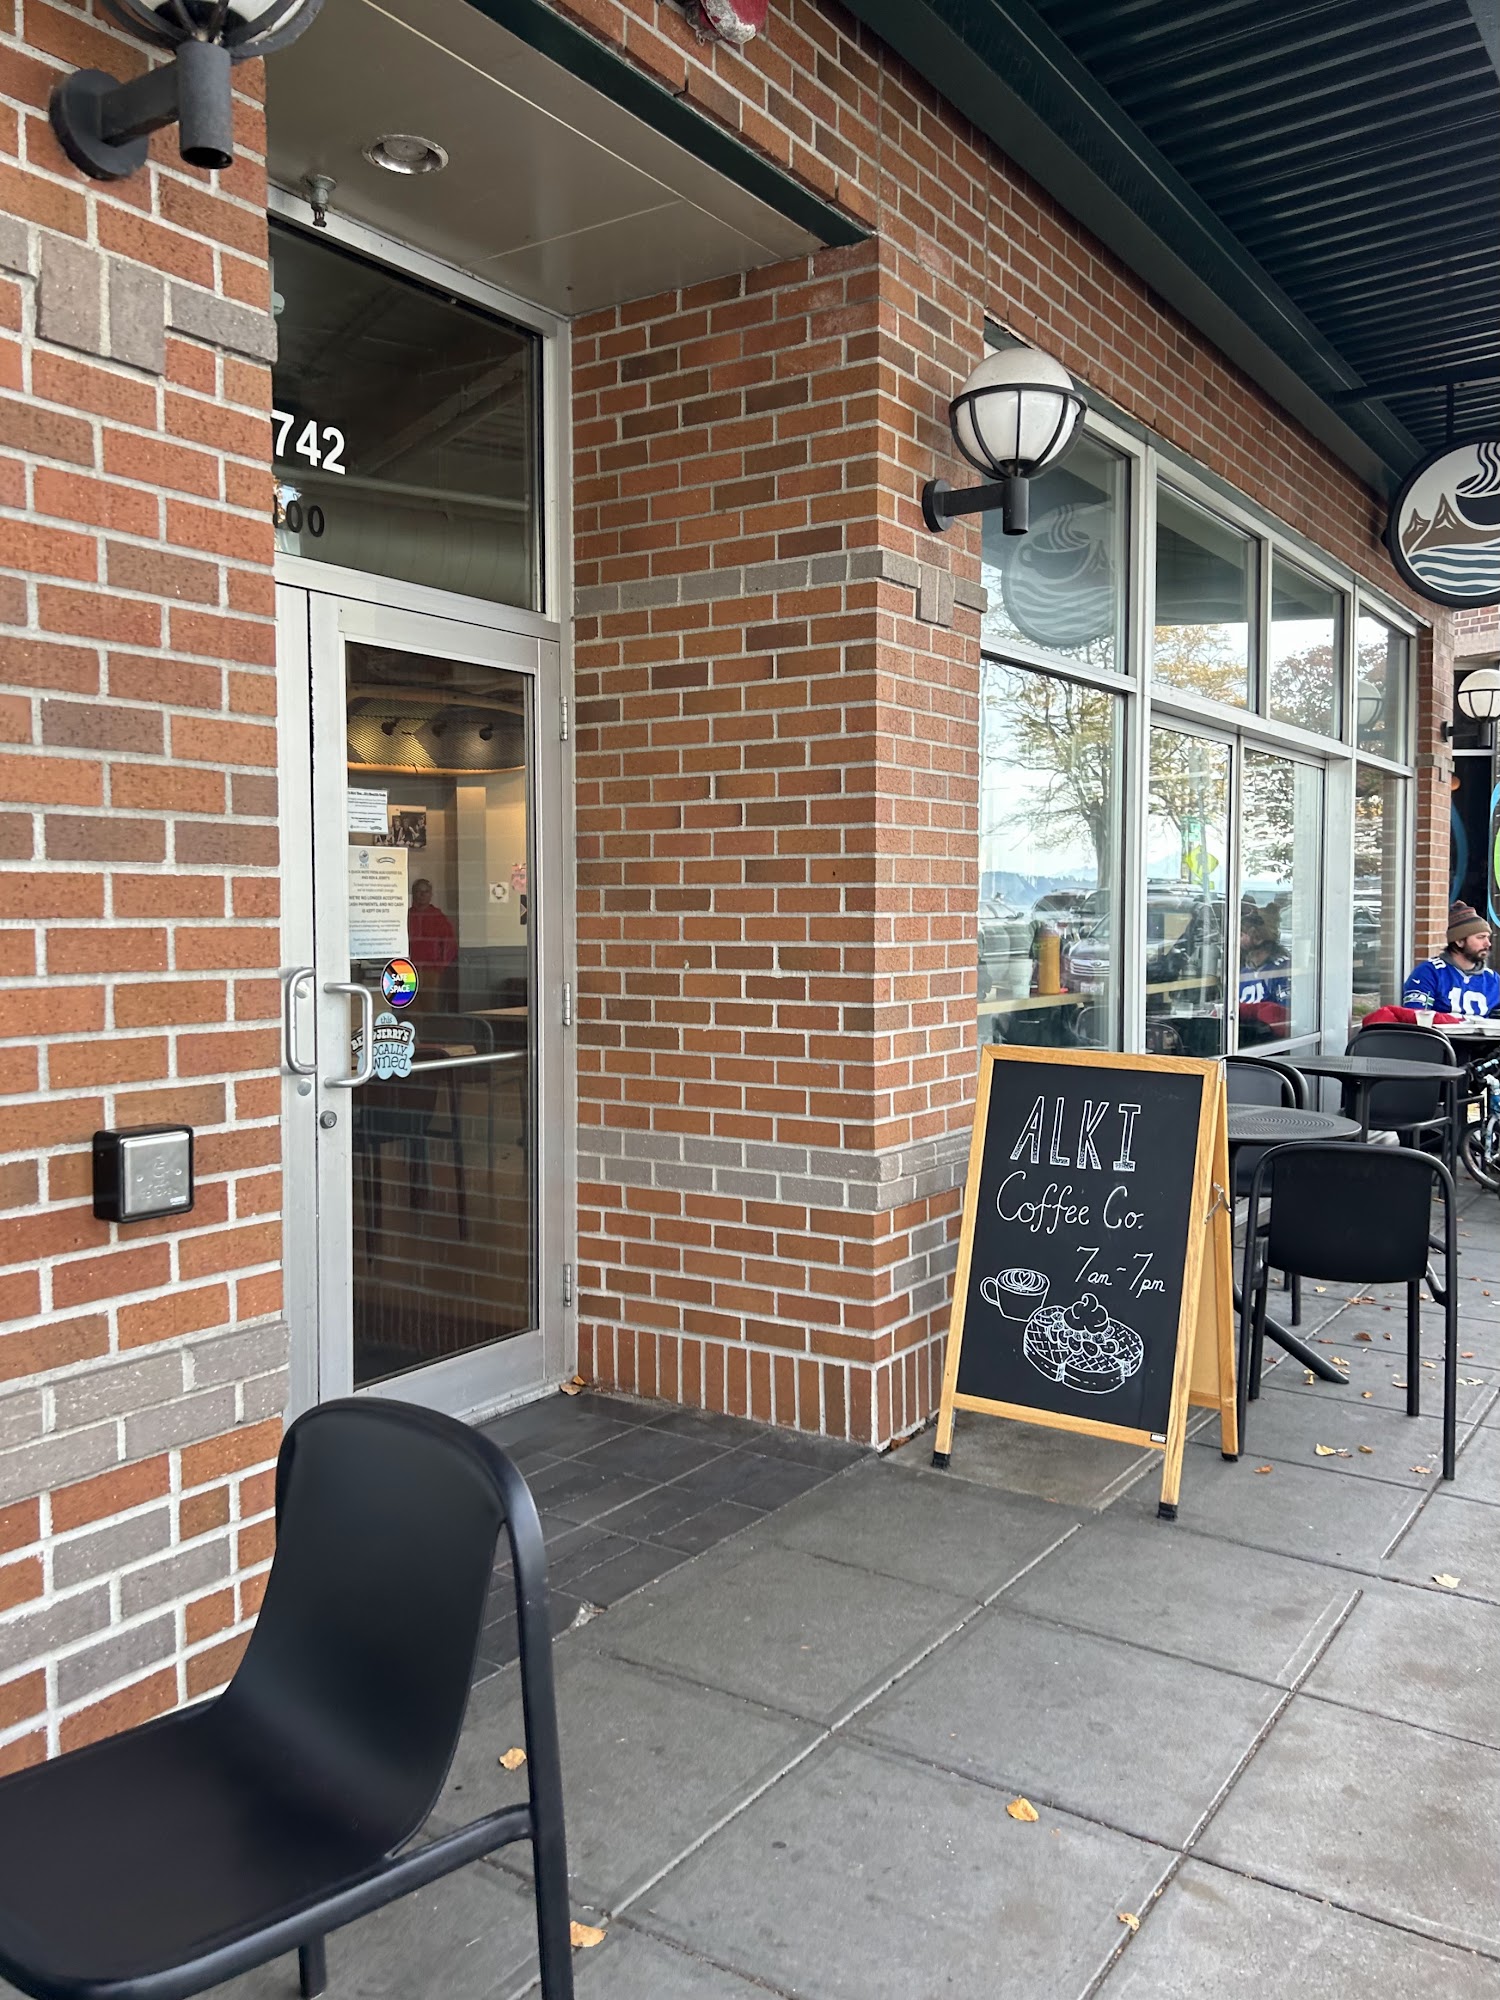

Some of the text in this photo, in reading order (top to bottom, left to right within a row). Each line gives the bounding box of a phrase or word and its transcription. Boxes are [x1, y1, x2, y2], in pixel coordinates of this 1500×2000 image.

[271, 409, 346, 475] 742
[391, 973, 408, 982] SAFE
[390, 984, 411, 994] SPACE
[1448, 986, 1489, 1017] 10
[380, 1015, 393, 1024] this
[372, 1043, 408, 1057] OCALLY
[1009, 1095, 1142, 1173] ALKI
[996, 1170, 1144, 1235] Coffee Co.
